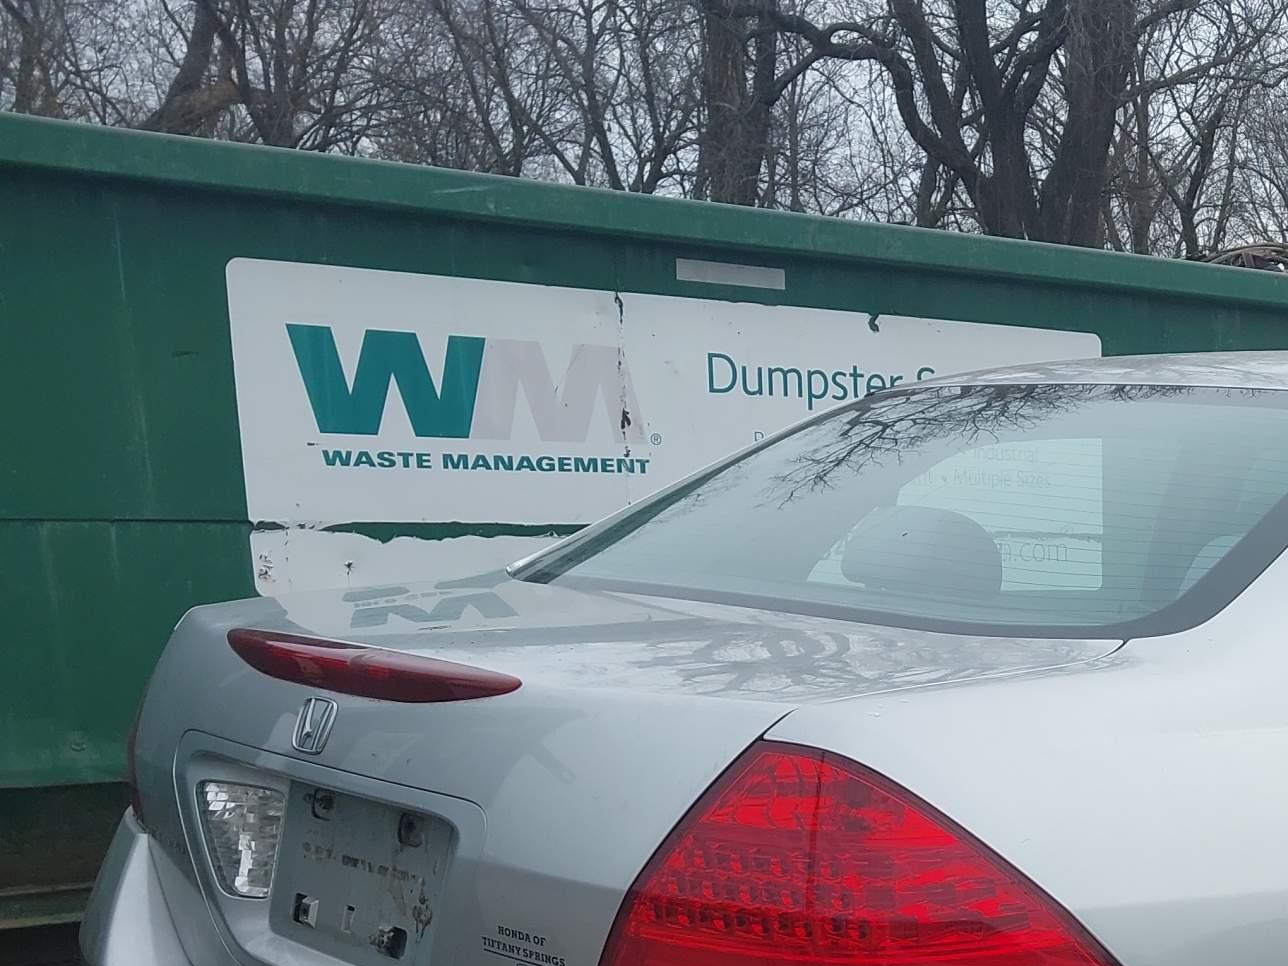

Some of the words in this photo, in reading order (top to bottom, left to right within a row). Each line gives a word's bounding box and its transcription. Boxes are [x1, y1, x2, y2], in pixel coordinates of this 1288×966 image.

[285, 323, 649, 444] WM
[707, 352, 904, 411] Dumpster
[322, 449, 433, 469] WASTE
[442, 453, 651, 475] MANAGEMENT
[498, 925, 531, 943] HONDA
[532, 935, 546, 946] OF
